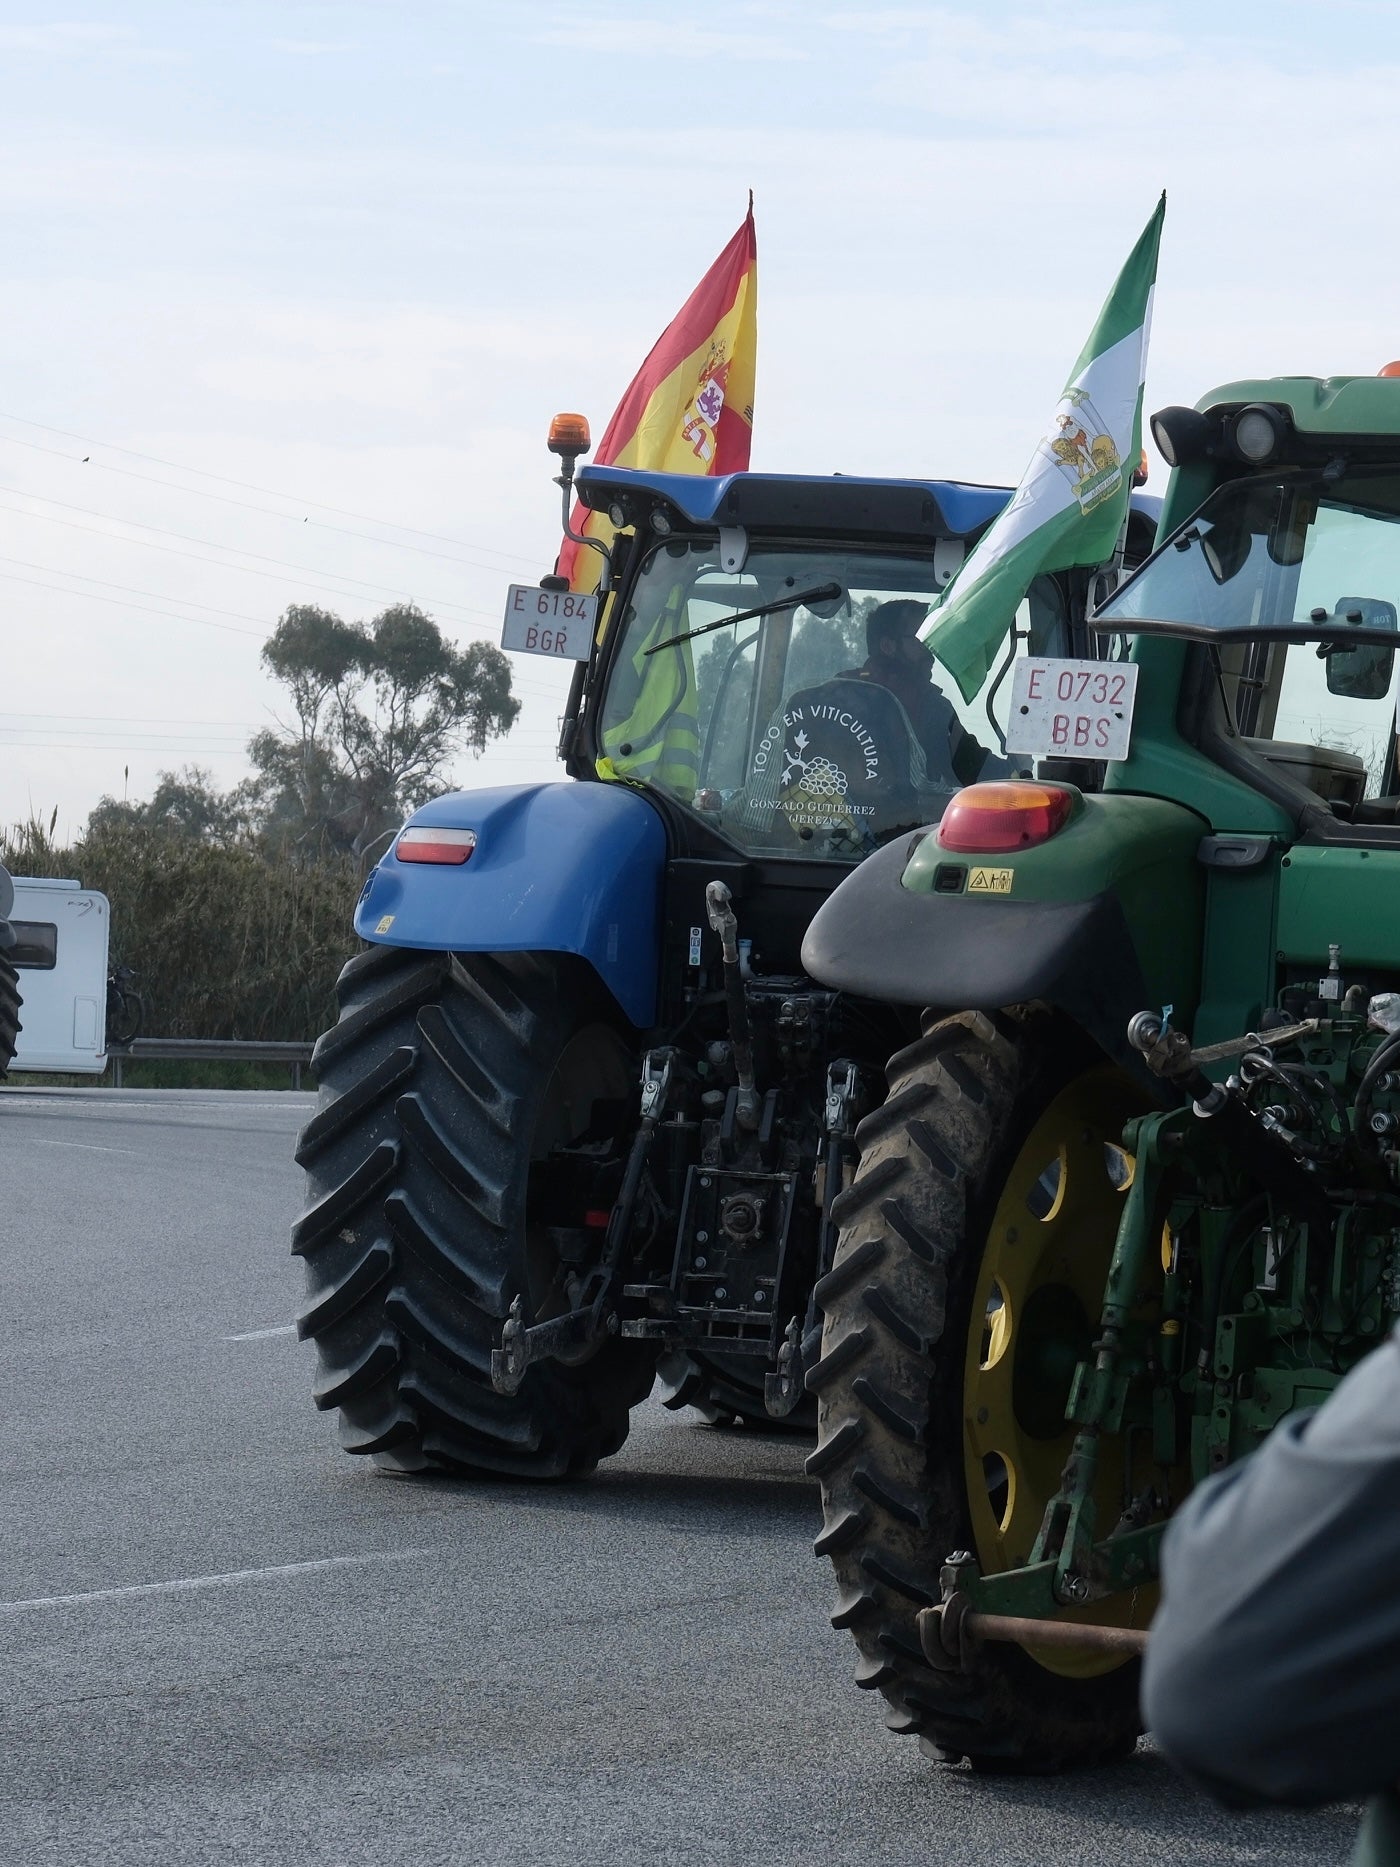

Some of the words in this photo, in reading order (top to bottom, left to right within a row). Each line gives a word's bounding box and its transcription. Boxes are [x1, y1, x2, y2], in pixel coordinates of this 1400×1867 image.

[513, 589, 528, 612] E
[537, 593, 587, 620] 6184
[525, 627, 567, 653] BGR
[1028, 669, 1045, 699] E
[1057, 671, 1126, 705] 0732
[753, 726, 780, 774] TODO
[783, 708, 804, 727] EN
[810, 705, 879, 780] VITICULTURA
[1052, 714, 1111, 748] BBS
[750, 798, 804, 811] GONZALO
